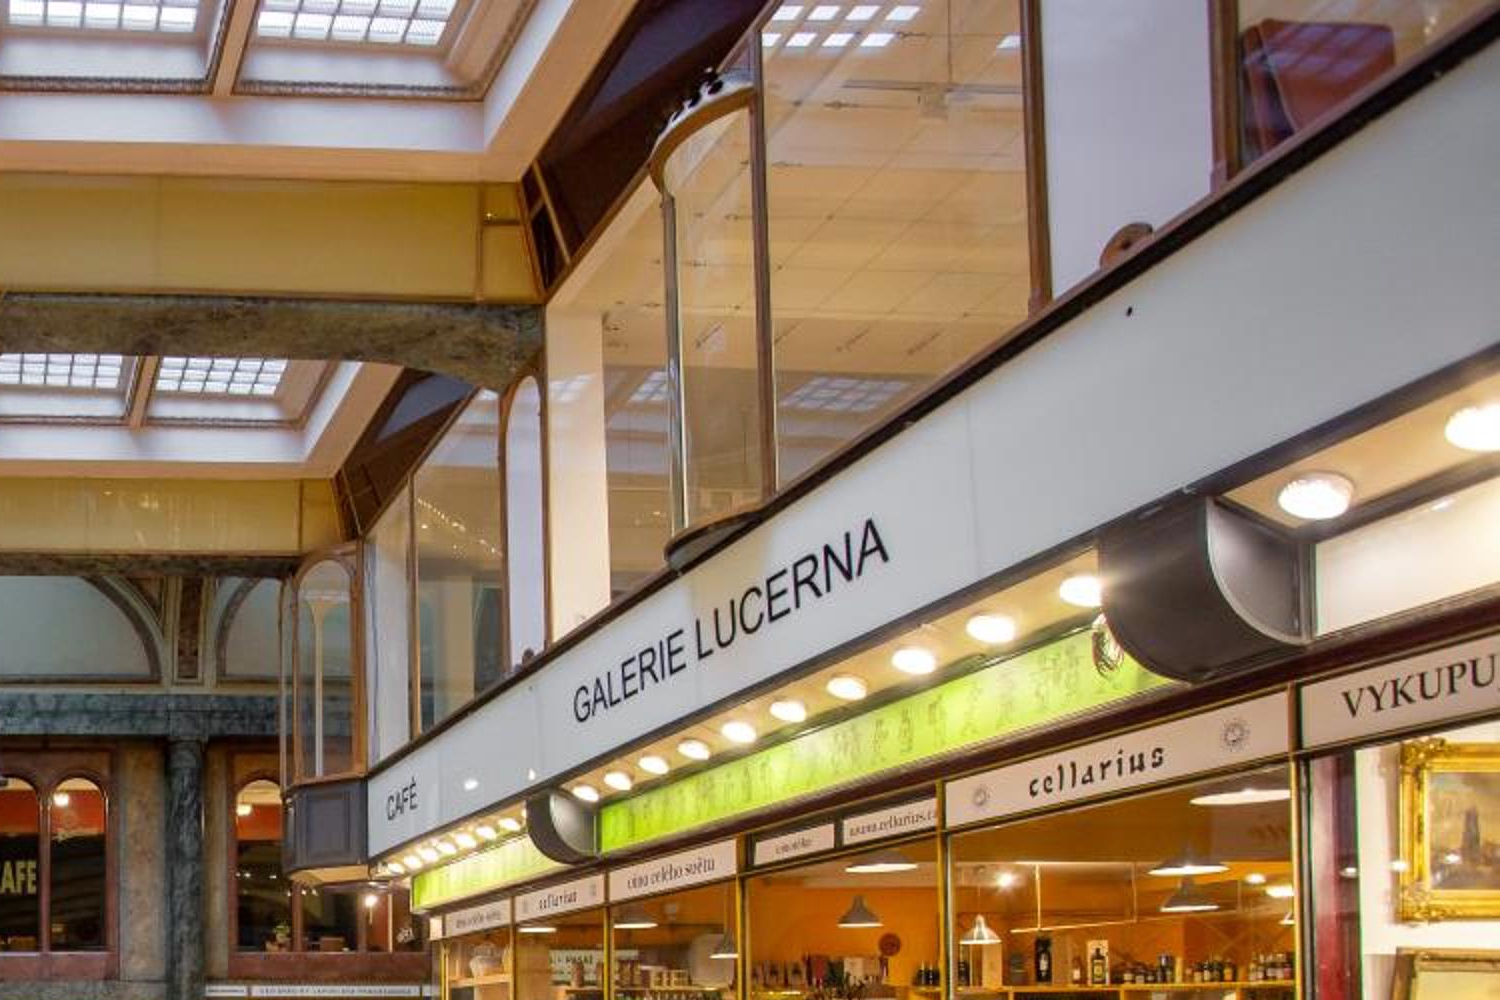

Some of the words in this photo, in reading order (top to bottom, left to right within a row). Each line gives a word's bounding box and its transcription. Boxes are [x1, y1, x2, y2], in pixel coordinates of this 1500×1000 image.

[573, 629, 687, 723] GALERIE
[695, 517, 889, 661] LUCERNA
[1341, 653, 1500, 718] VYKUPU
[386, 776, 419, 821] CAFÉ
[1028, 747, 1165, 798] cellarius
